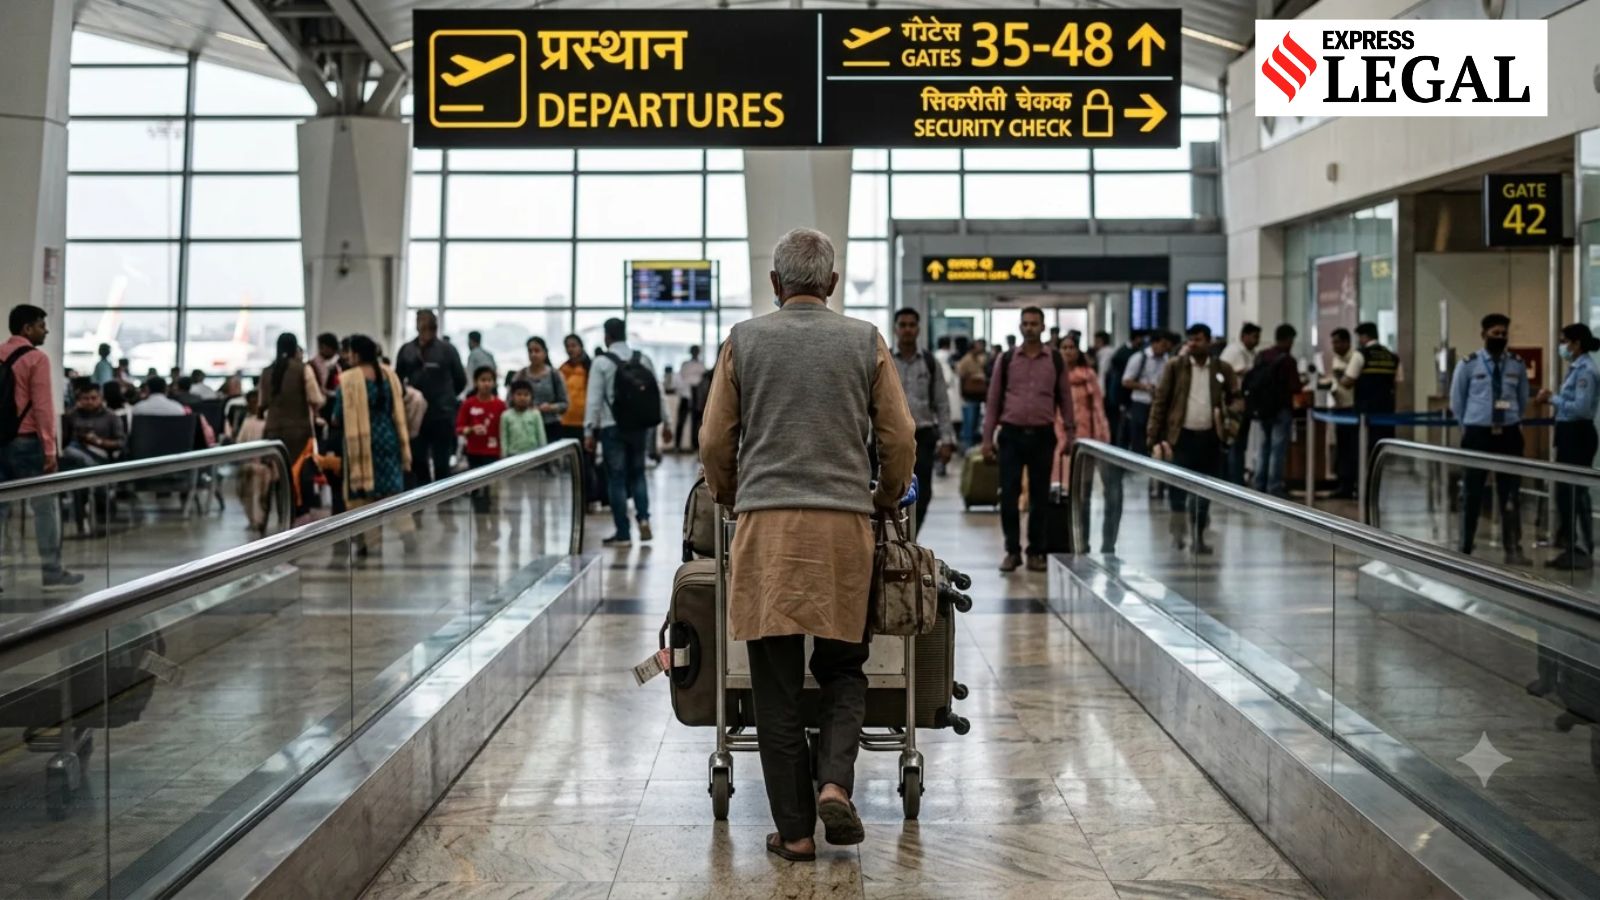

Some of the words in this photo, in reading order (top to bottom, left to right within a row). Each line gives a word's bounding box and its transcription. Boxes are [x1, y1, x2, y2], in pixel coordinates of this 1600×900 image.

[538, 30, 689, 70] प्रस्थान
[901, 48, 962, 68] GATES
[971, 22, 1114, 68] 35-48
[538, 92, 785, 129] DEPARTURES
[914, 118, 1004, 138] SECURITY
[1008, 118, 1073, 138] CHECK
[1503, 183, 1546, 198] GATE
[1503, 203, 1546, 234] 42
[1010, 259, 1036, 280] 42
